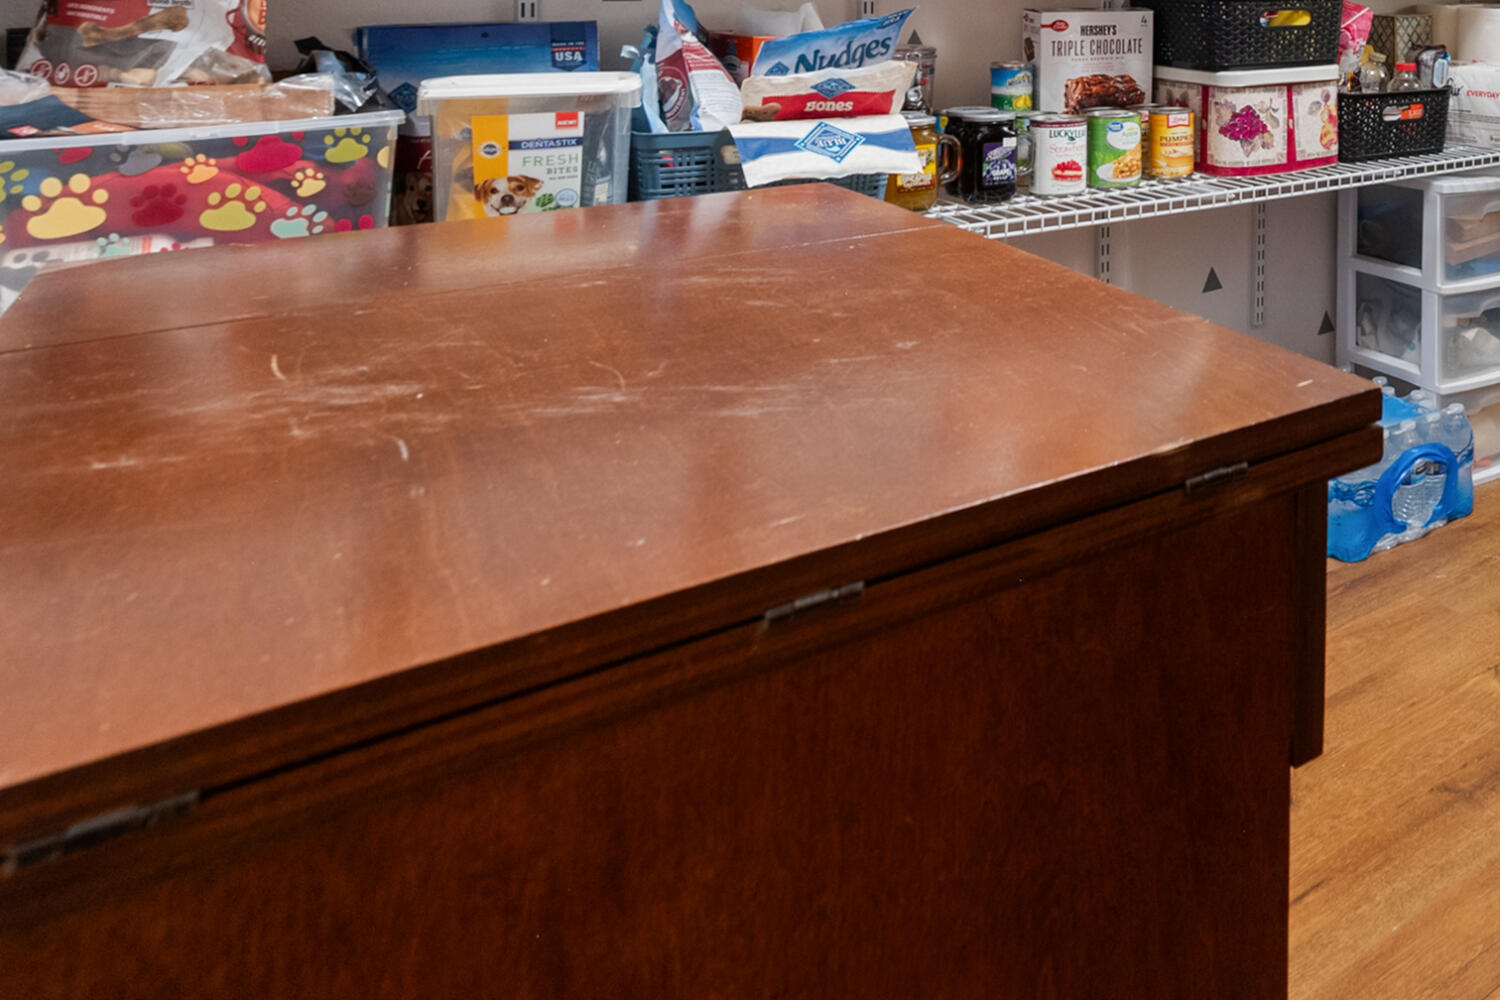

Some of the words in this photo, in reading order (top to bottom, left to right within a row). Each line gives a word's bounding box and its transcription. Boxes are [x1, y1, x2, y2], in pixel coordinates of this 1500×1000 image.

[1140, 16, 1148, 24] 4
[1080, 24, 1117, 37] HERSHEY'S
[1051, 40, 1086, 57] TRIPLE
[1089, 38, 1143, 55] CHOCOLATE
[554, 51, 584, 62] USA
[794, 35, 893, 73] Nudges
[1466, 89, 1500, 99] EVERYDAY
[521, 137, 578, 149] DENTASTIX
[522, 153, 579, 168] FRESH
[546, 166, 578, 176] BITES
